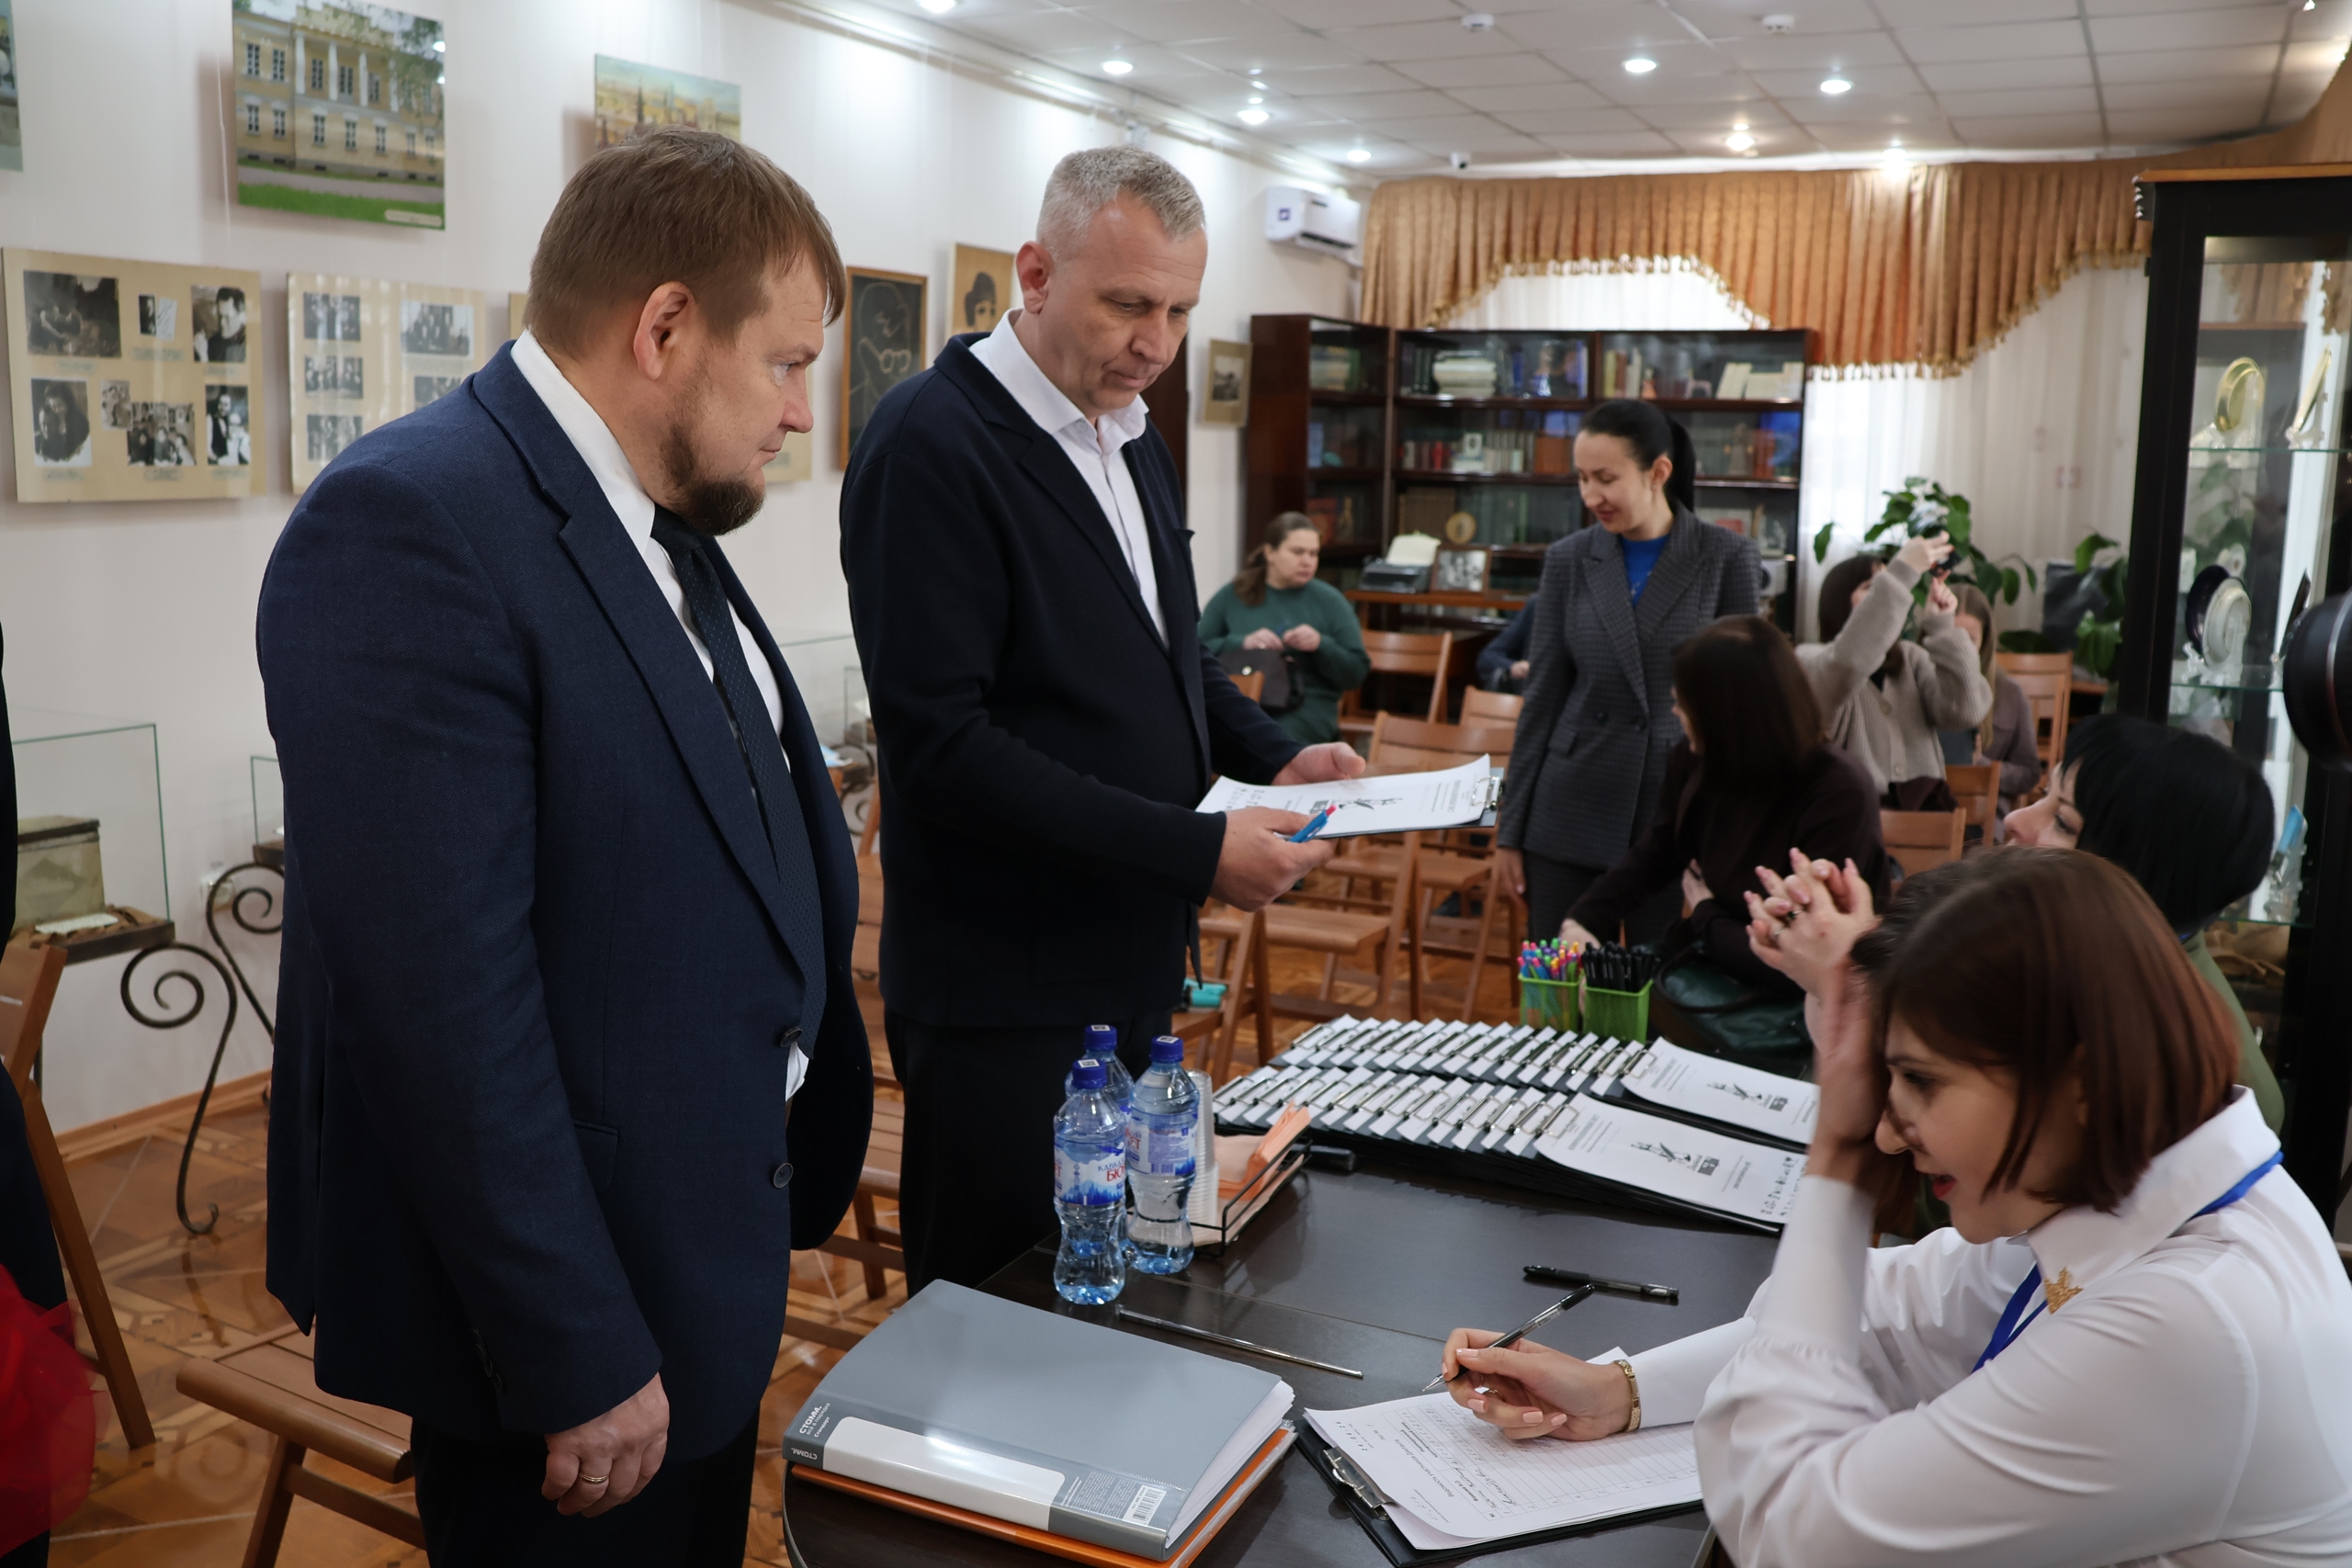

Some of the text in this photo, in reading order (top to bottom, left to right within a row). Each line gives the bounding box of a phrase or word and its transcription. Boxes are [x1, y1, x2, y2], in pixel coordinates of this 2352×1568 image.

[814, 1416, 831, 1438] Стандарт
[1411, 1455, 1435, 1477] участников
[1432, 1476, 1454, 1497] Ведомость
